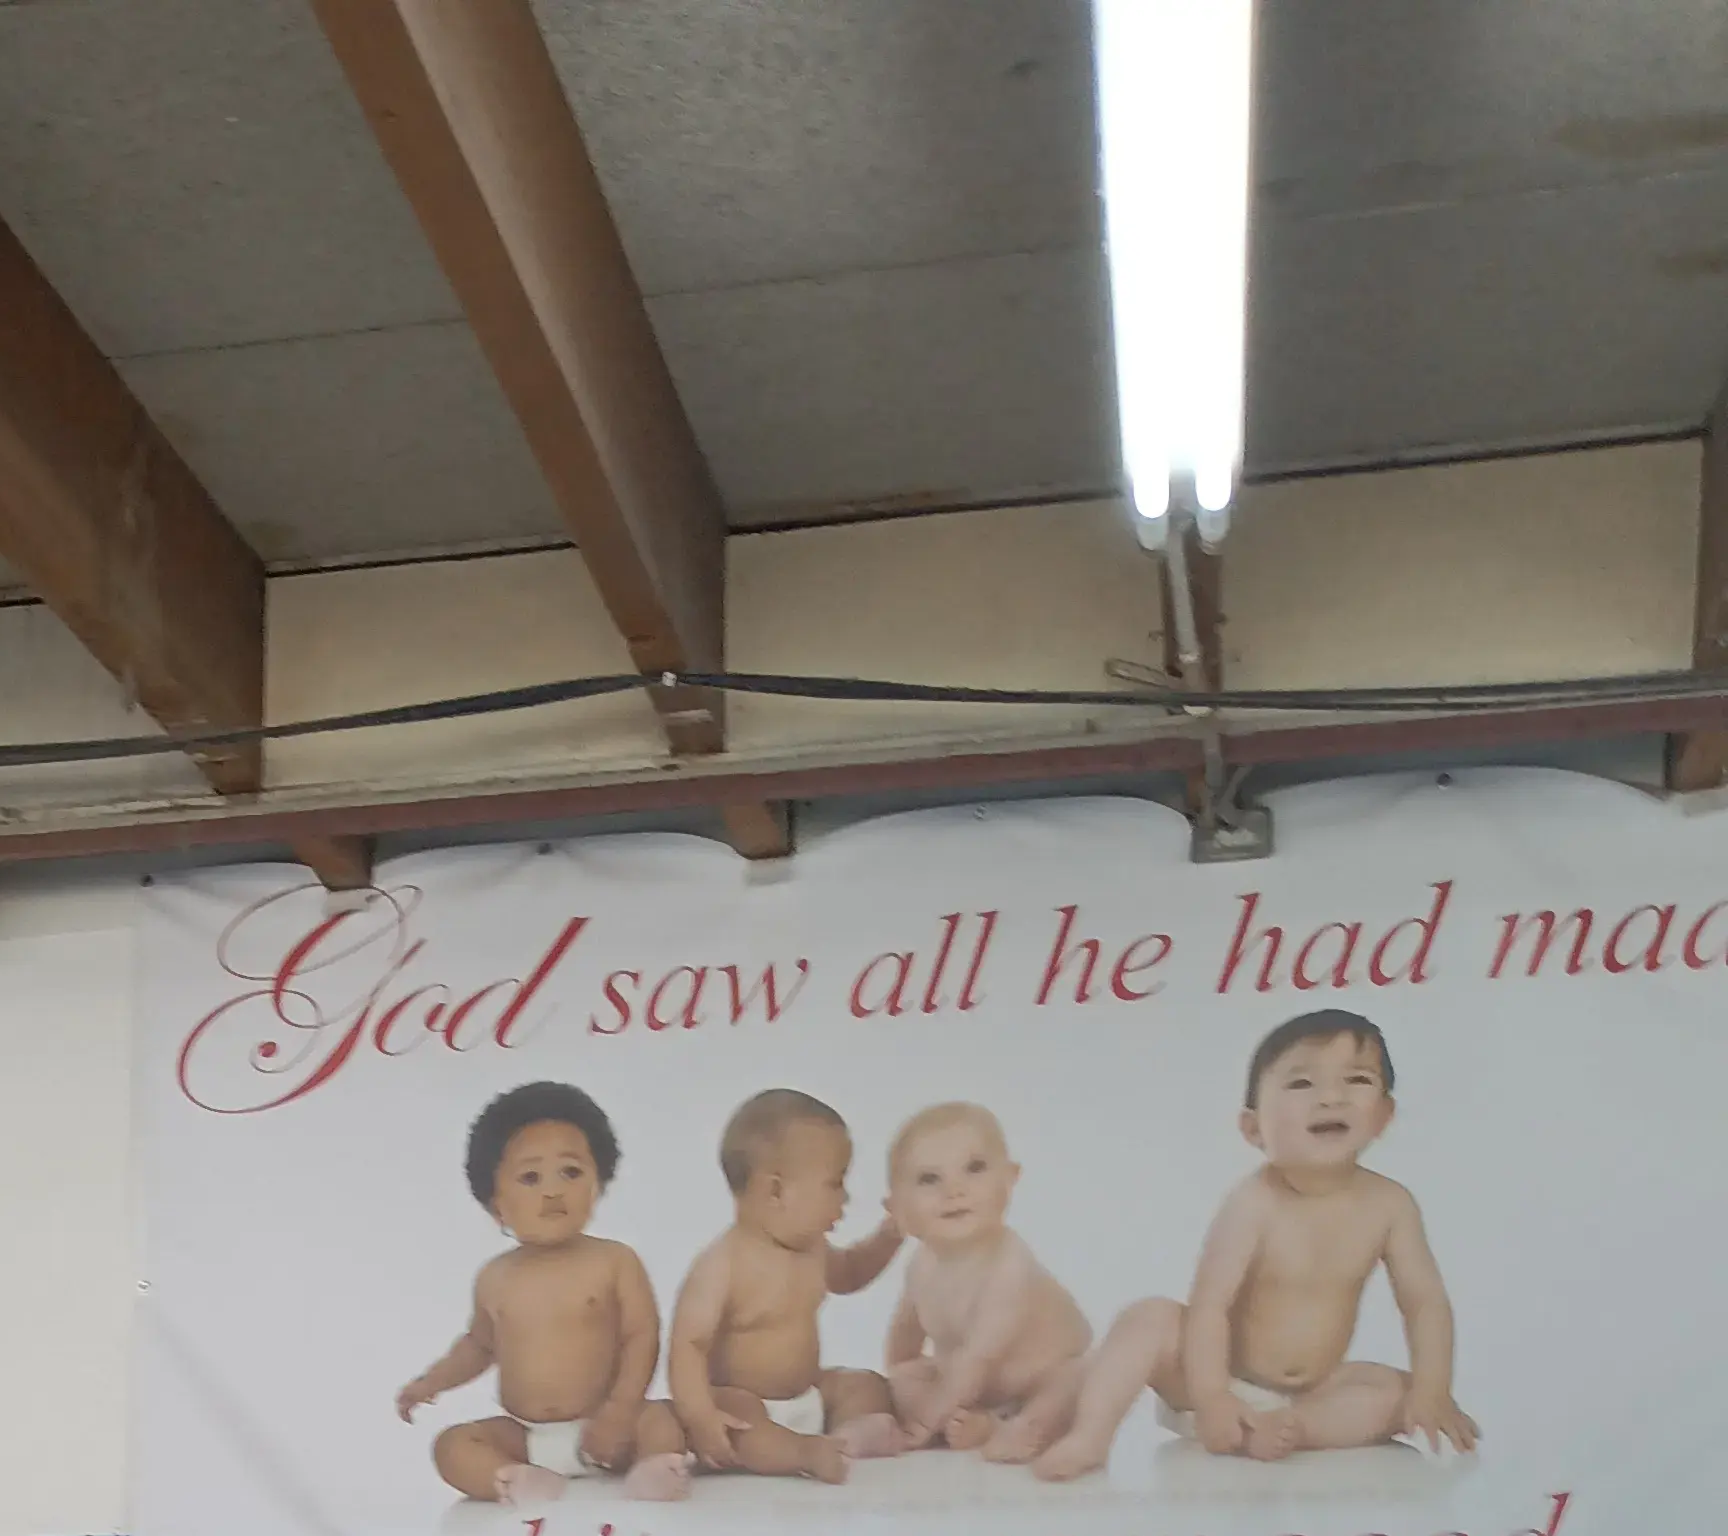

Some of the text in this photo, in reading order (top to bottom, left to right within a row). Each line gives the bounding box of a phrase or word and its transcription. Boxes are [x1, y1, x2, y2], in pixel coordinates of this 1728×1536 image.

[176, 883, 592, 1114] God
[587, 962, 810, 1035] saw
[847, 909, 999, 1020] all
[1034, 903, 1180, 1006] he
[1214, 879, 1454, 994] had
